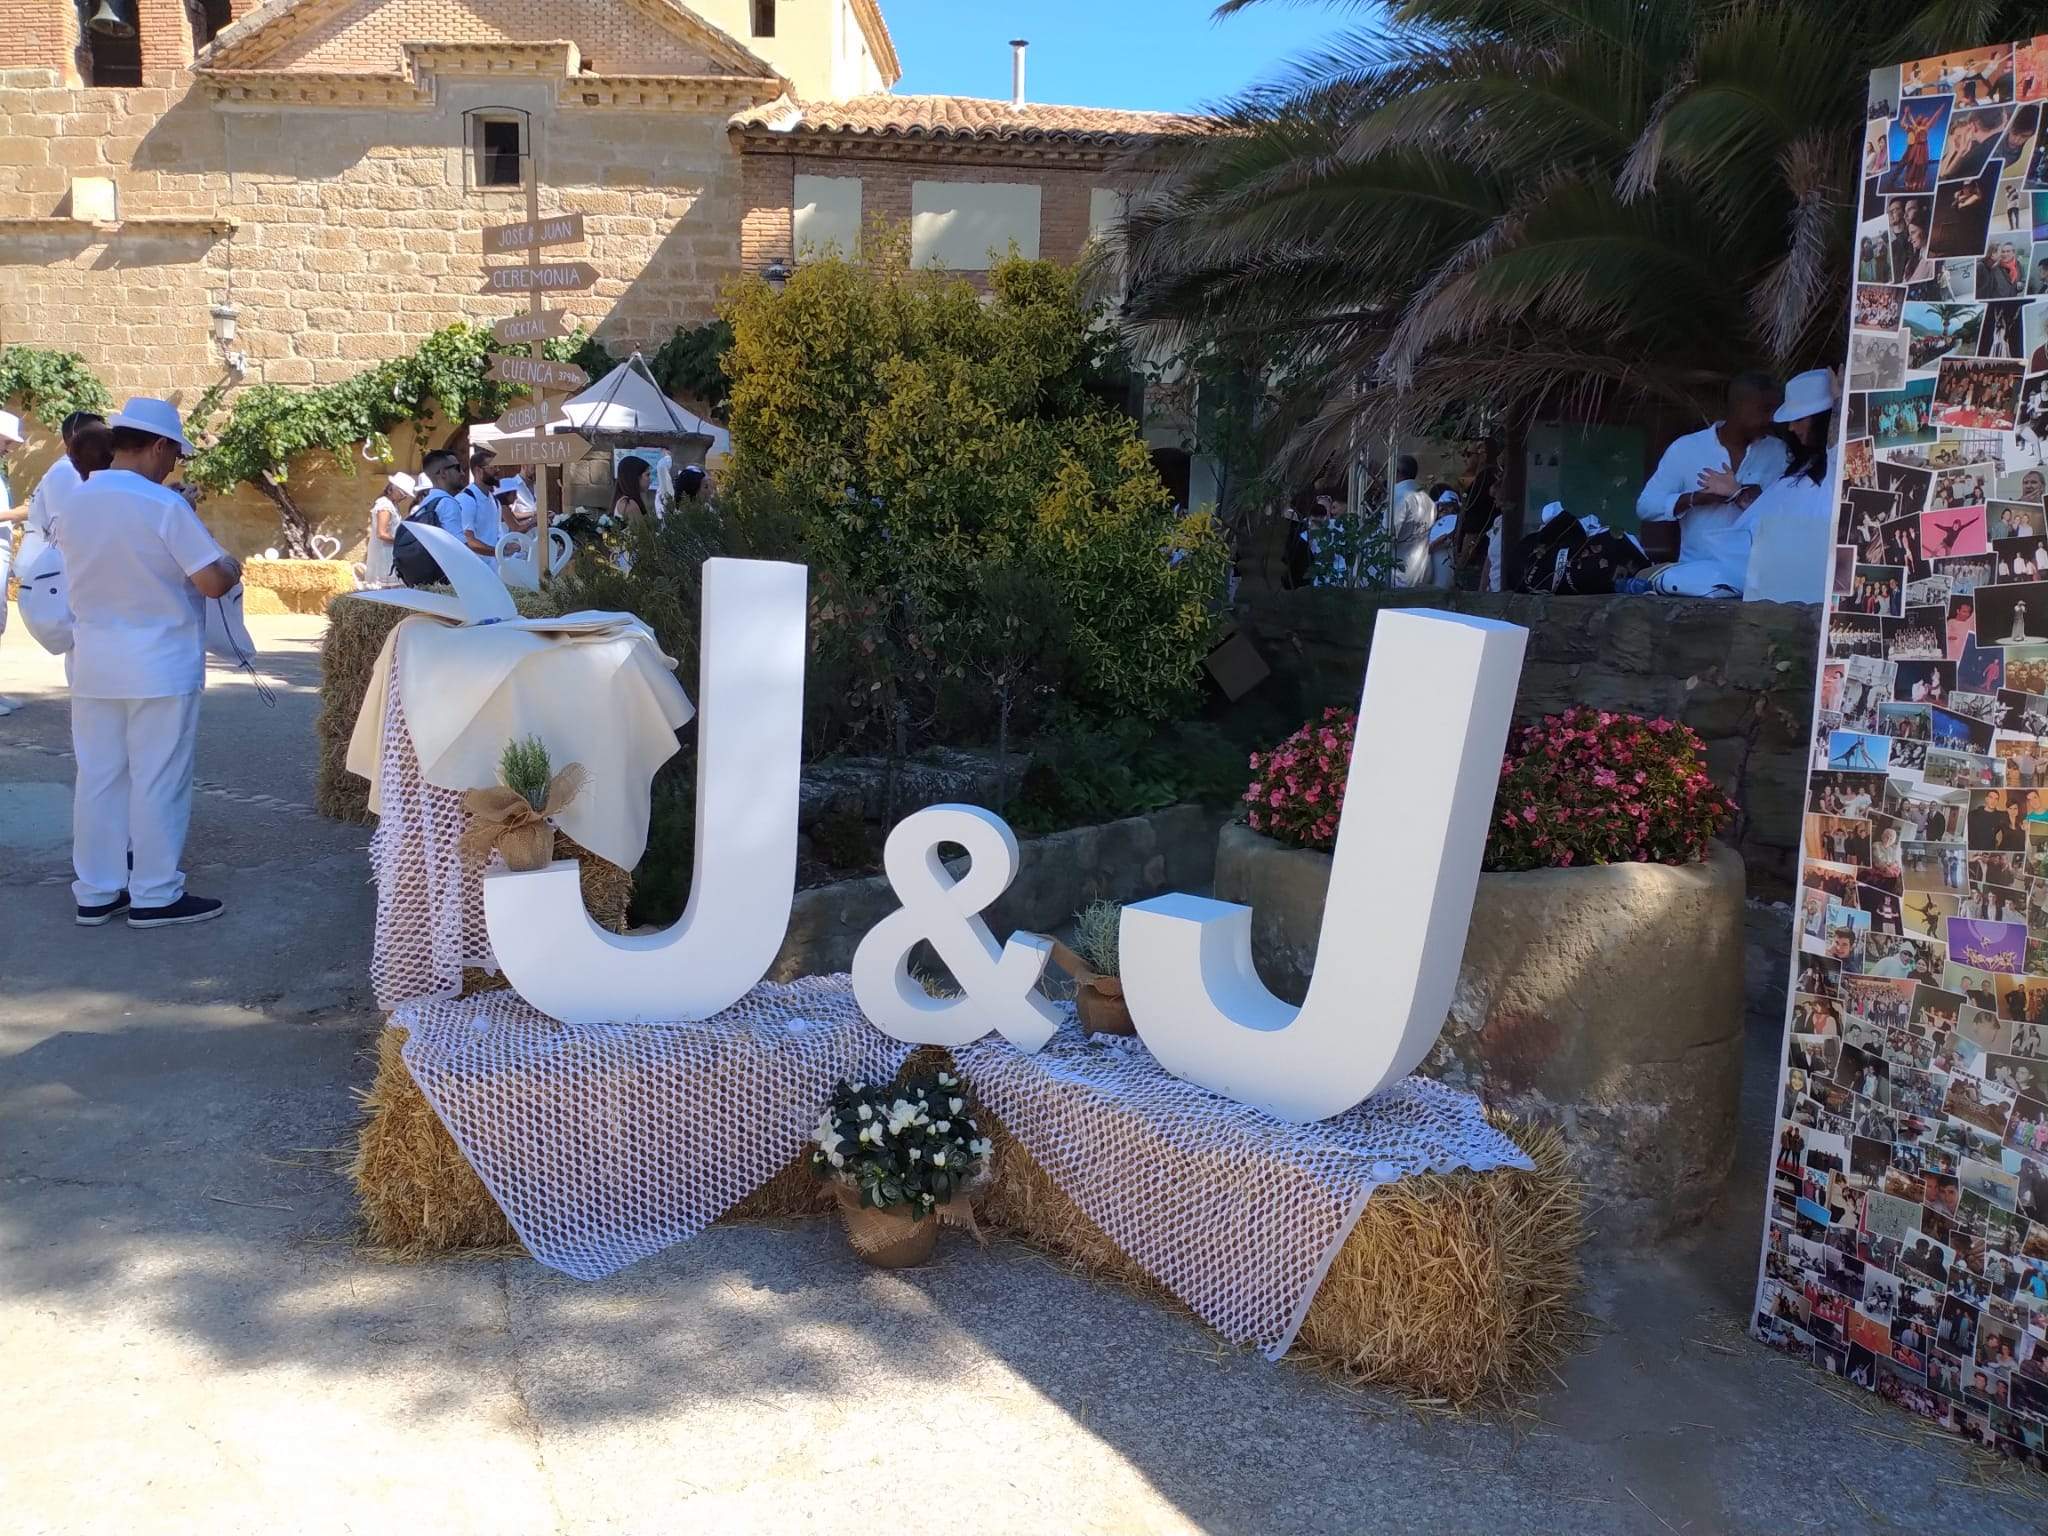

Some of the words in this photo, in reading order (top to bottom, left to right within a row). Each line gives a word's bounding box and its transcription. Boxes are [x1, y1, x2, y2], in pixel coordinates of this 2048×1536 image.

[498, 225, 526, 247] JOSÉ
[541, 220, 572, 241] JUAN
[493, 268, 581, 289] CEREMONIA
[504, 319, 546, 339] COCKTAIL
[502, 359, 553, 384] CUENCA
[508, 407, 537, 428] GLOBO
[484, 556, 808, 1024] J
[852, 802, 1067, 1053] &
[1119, 608, 1529, 1122] J
